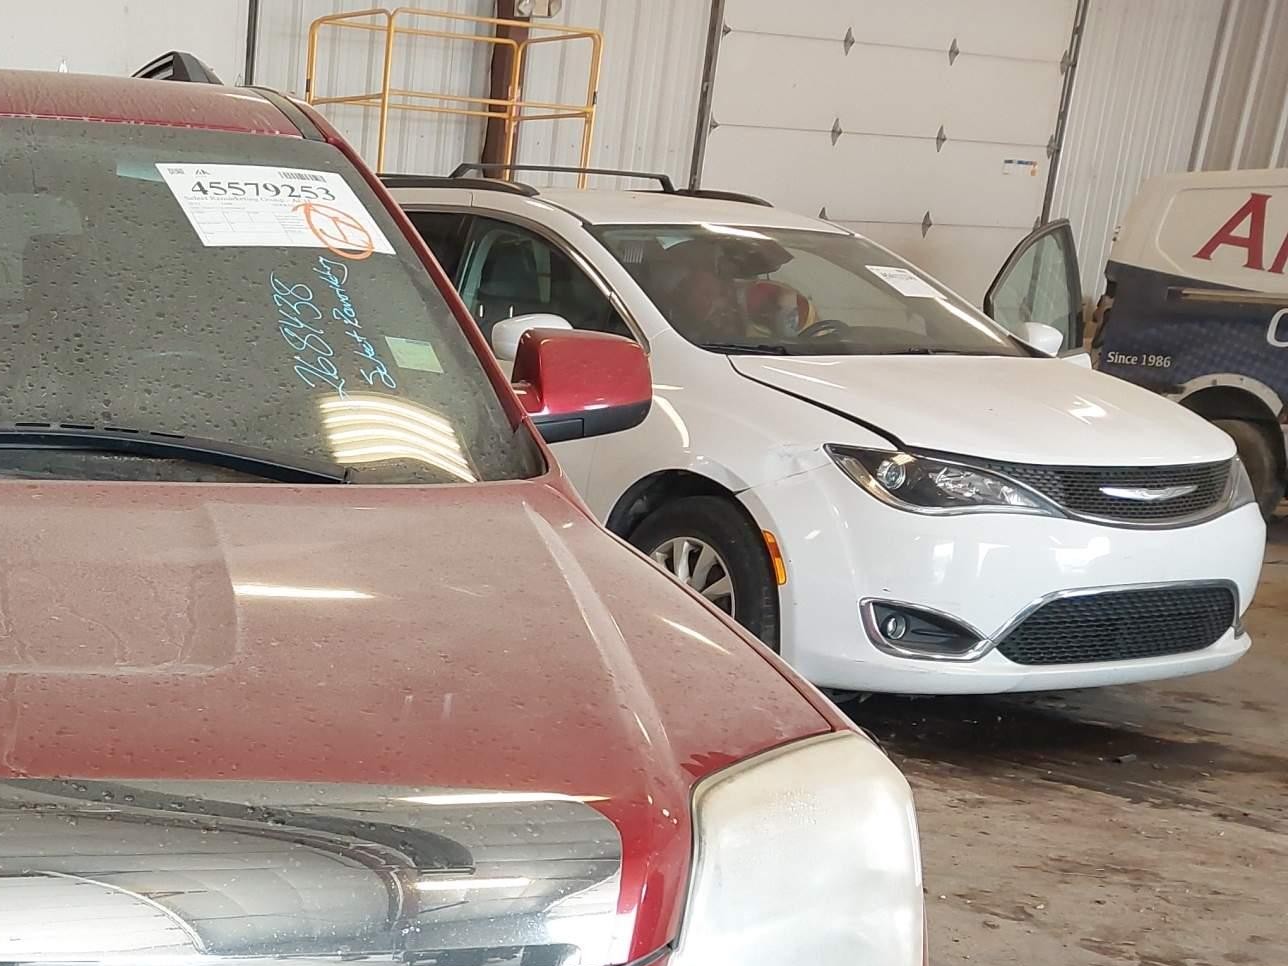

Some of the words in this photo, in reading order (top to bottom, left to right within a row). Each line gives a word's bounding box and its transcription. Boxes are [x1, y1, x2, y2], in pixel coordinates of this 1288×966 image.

[191, 181, 336, 201] 45579253
[1192, 193, 1288, 274] A
[1107, 351, 1138, 365] Since
[1141, 354, 1172, 368] 1986
